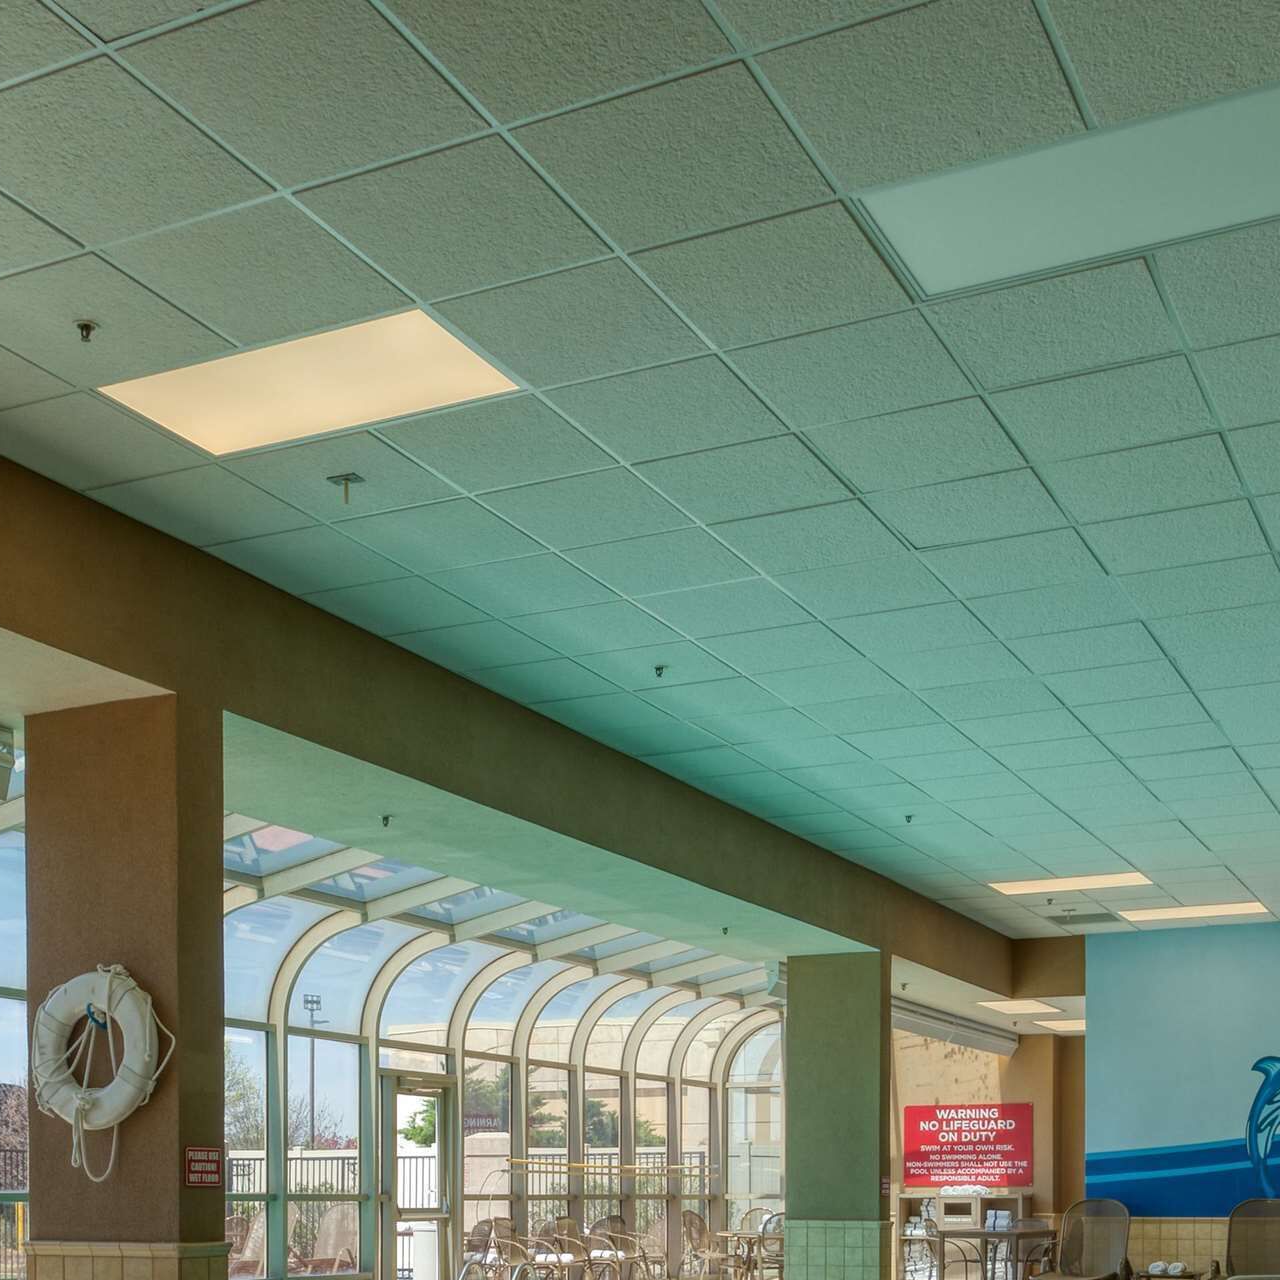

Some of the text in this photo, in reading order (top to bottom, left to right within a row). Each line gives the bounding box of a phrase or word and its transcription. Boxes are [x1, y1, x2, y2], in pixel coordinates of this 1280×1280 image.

[935, 1108, 999, 1119] WARNING
[919, 1120, 1016, 1131] NO LIFEGUARD
[938, 1131, 996, 1142] ON DUTY
